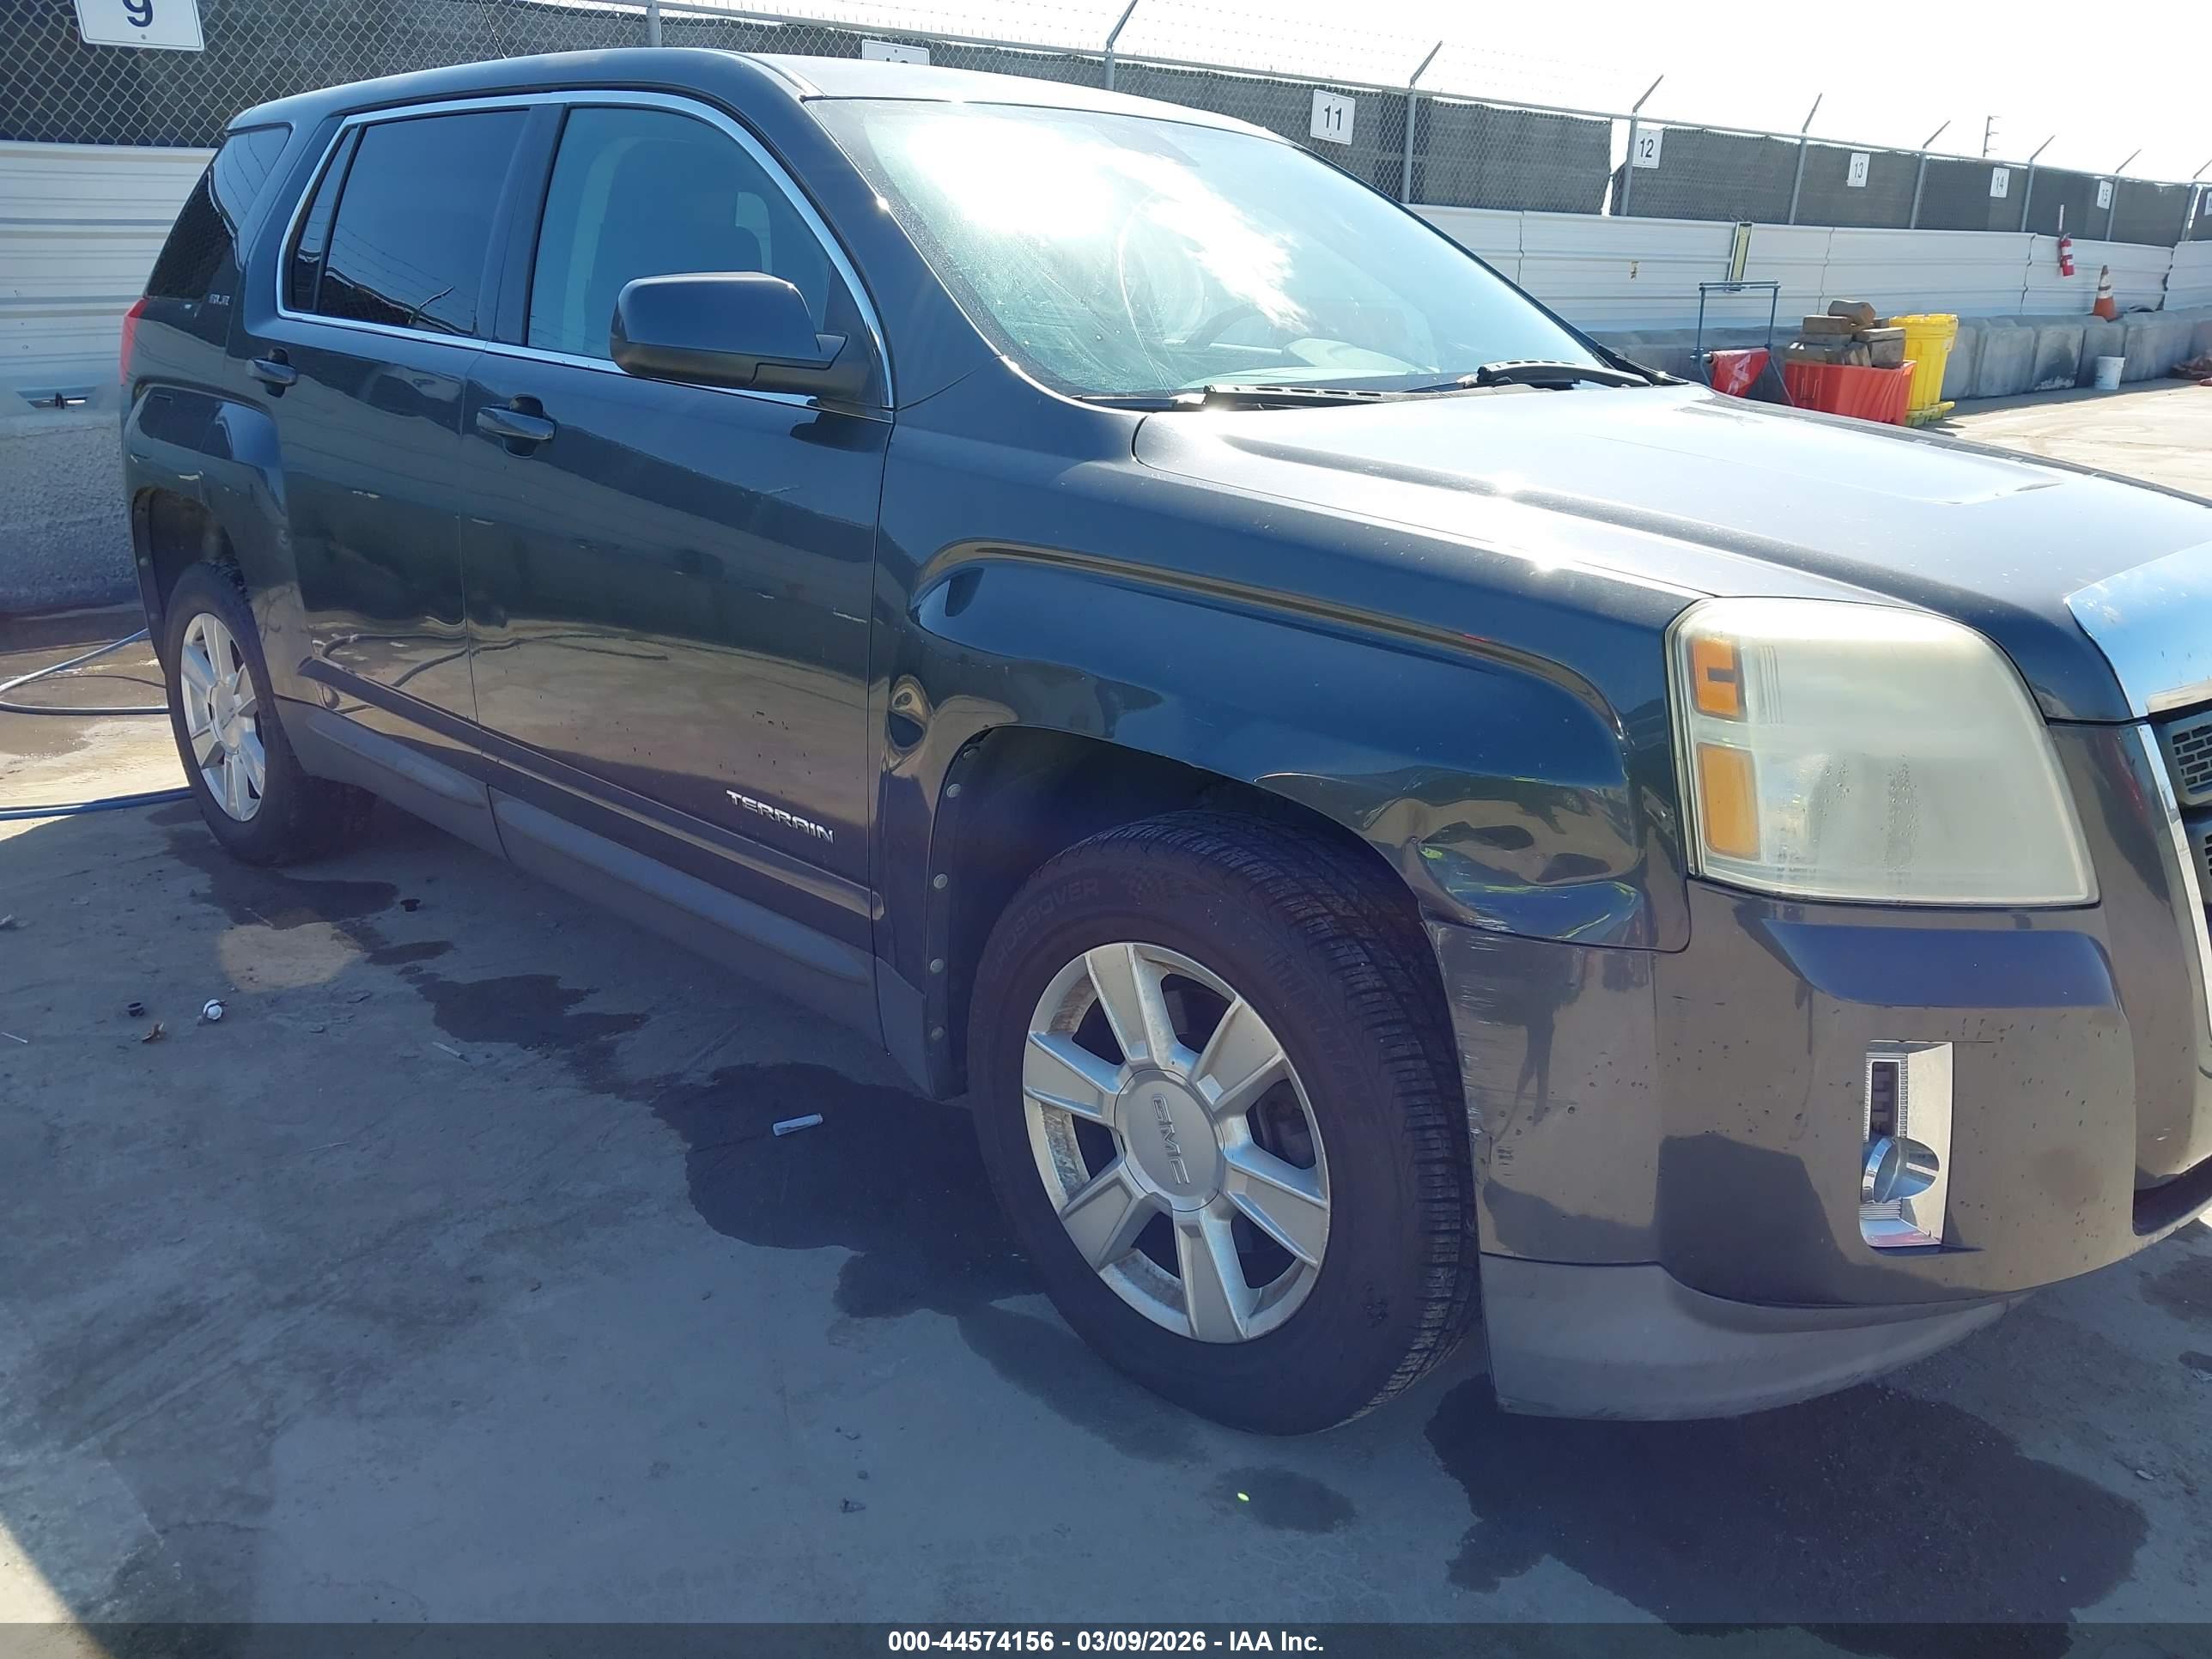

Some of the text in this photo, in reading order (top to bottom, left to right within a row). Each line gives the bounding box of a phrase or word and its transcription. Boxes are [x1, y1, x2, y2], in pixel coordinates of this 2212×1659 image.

[123, 0, 153, 27] 9
[1324, 105, 1342, 131] 11
[1640, 137, 1654, 158] 12
[1855, 162, 1863, 179] 13
[1996, 175, 2005, 190] 14
[726, 789, 833, 844] TERRAIN
[1152, 1093, 1191, 1184] GMC
